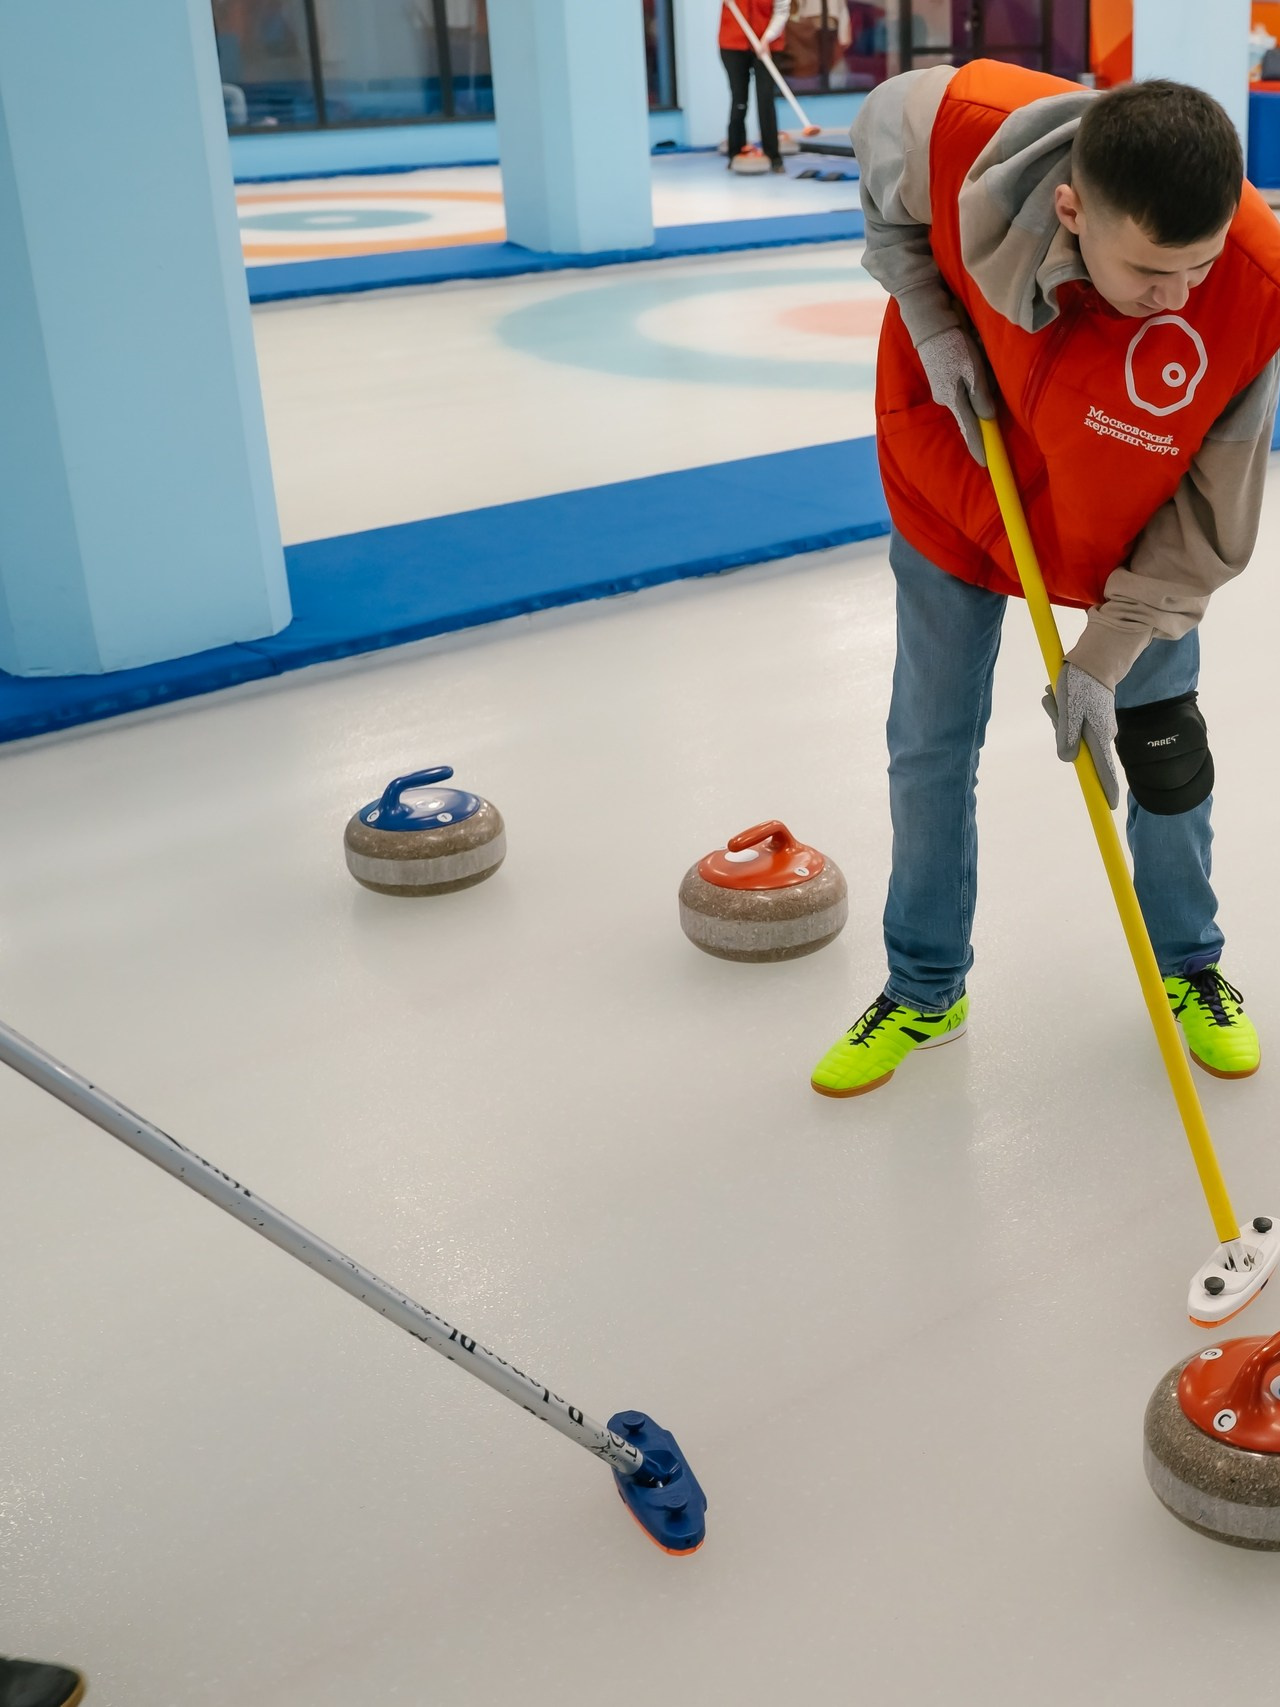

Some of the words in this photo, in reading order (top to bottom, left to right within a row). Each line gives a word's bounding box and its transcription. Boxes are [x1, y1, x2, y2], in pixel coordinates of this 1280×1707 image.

[1083, 417, 1180, 456] керлинг-клуб
[1086, 405, 1174, 445] Московский
[1217, 1412, 1232, 1428] C
